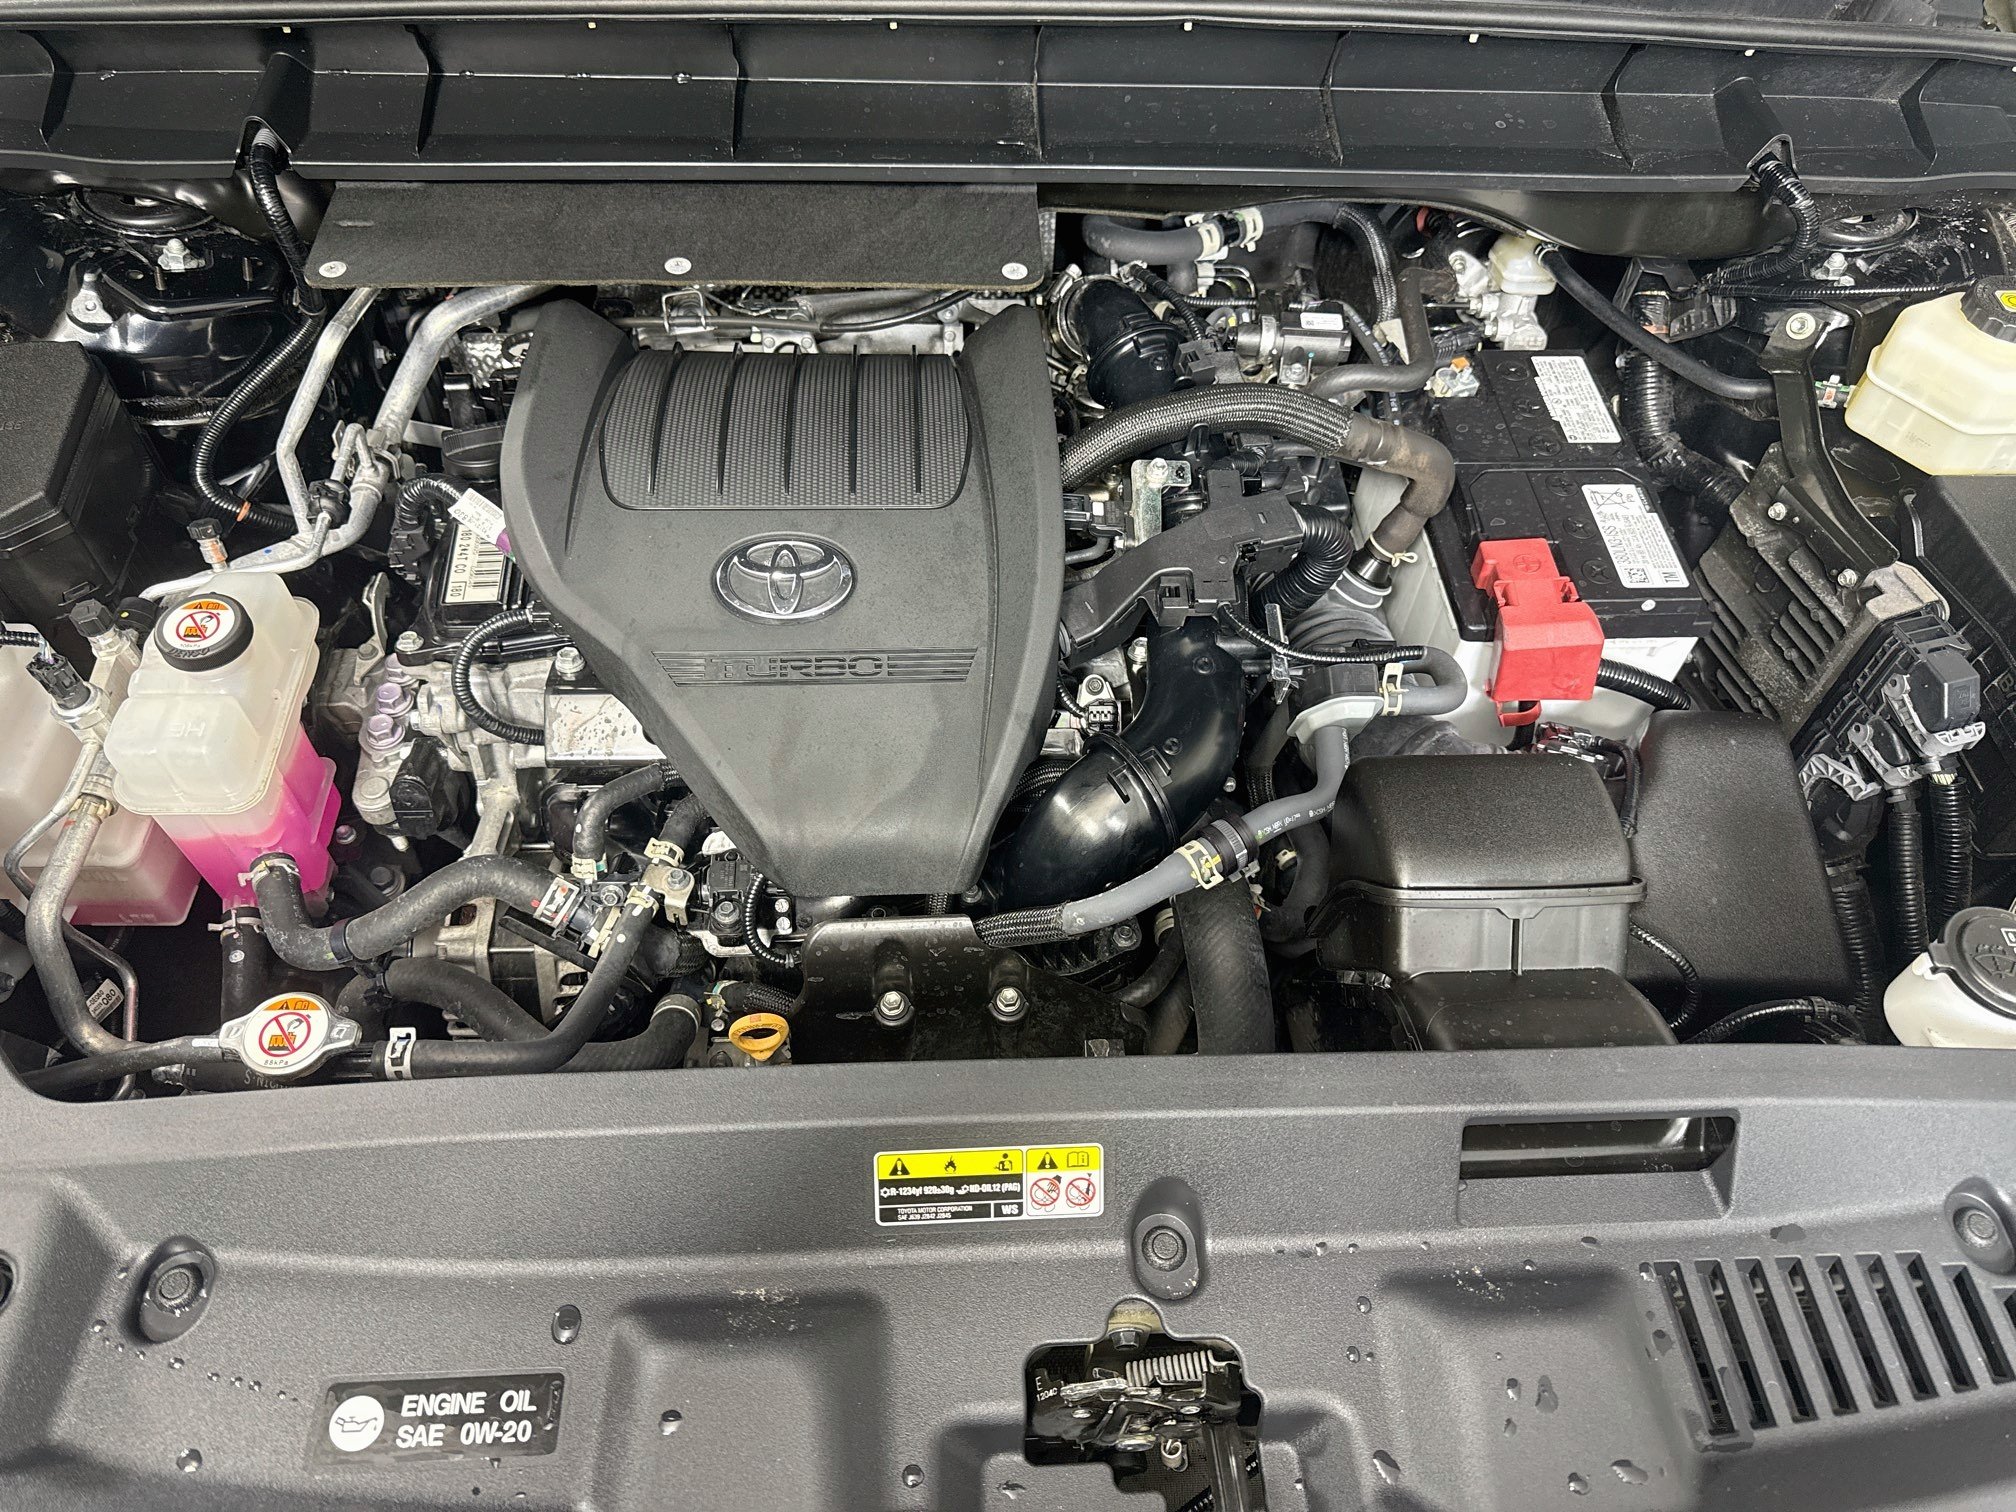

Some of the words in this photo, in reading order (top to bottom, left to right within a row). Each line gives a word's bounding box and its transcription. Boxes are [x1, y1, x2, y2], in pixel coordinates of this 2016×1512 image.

[710, 655, 883, 679] TURBO
[897, 1207, 917, 1215] TOYOTA
[937, 1205, 973, 1213] CORPORATION
[1001, 1204, 1019, 1215] WS
[401, 1391, 487, 1418] ENGINE
[499, 1389, 537, 1413] OIL
[395, 1423, 446, 1449] SAE
[459, 1420, 532, 1446] 0W-20
